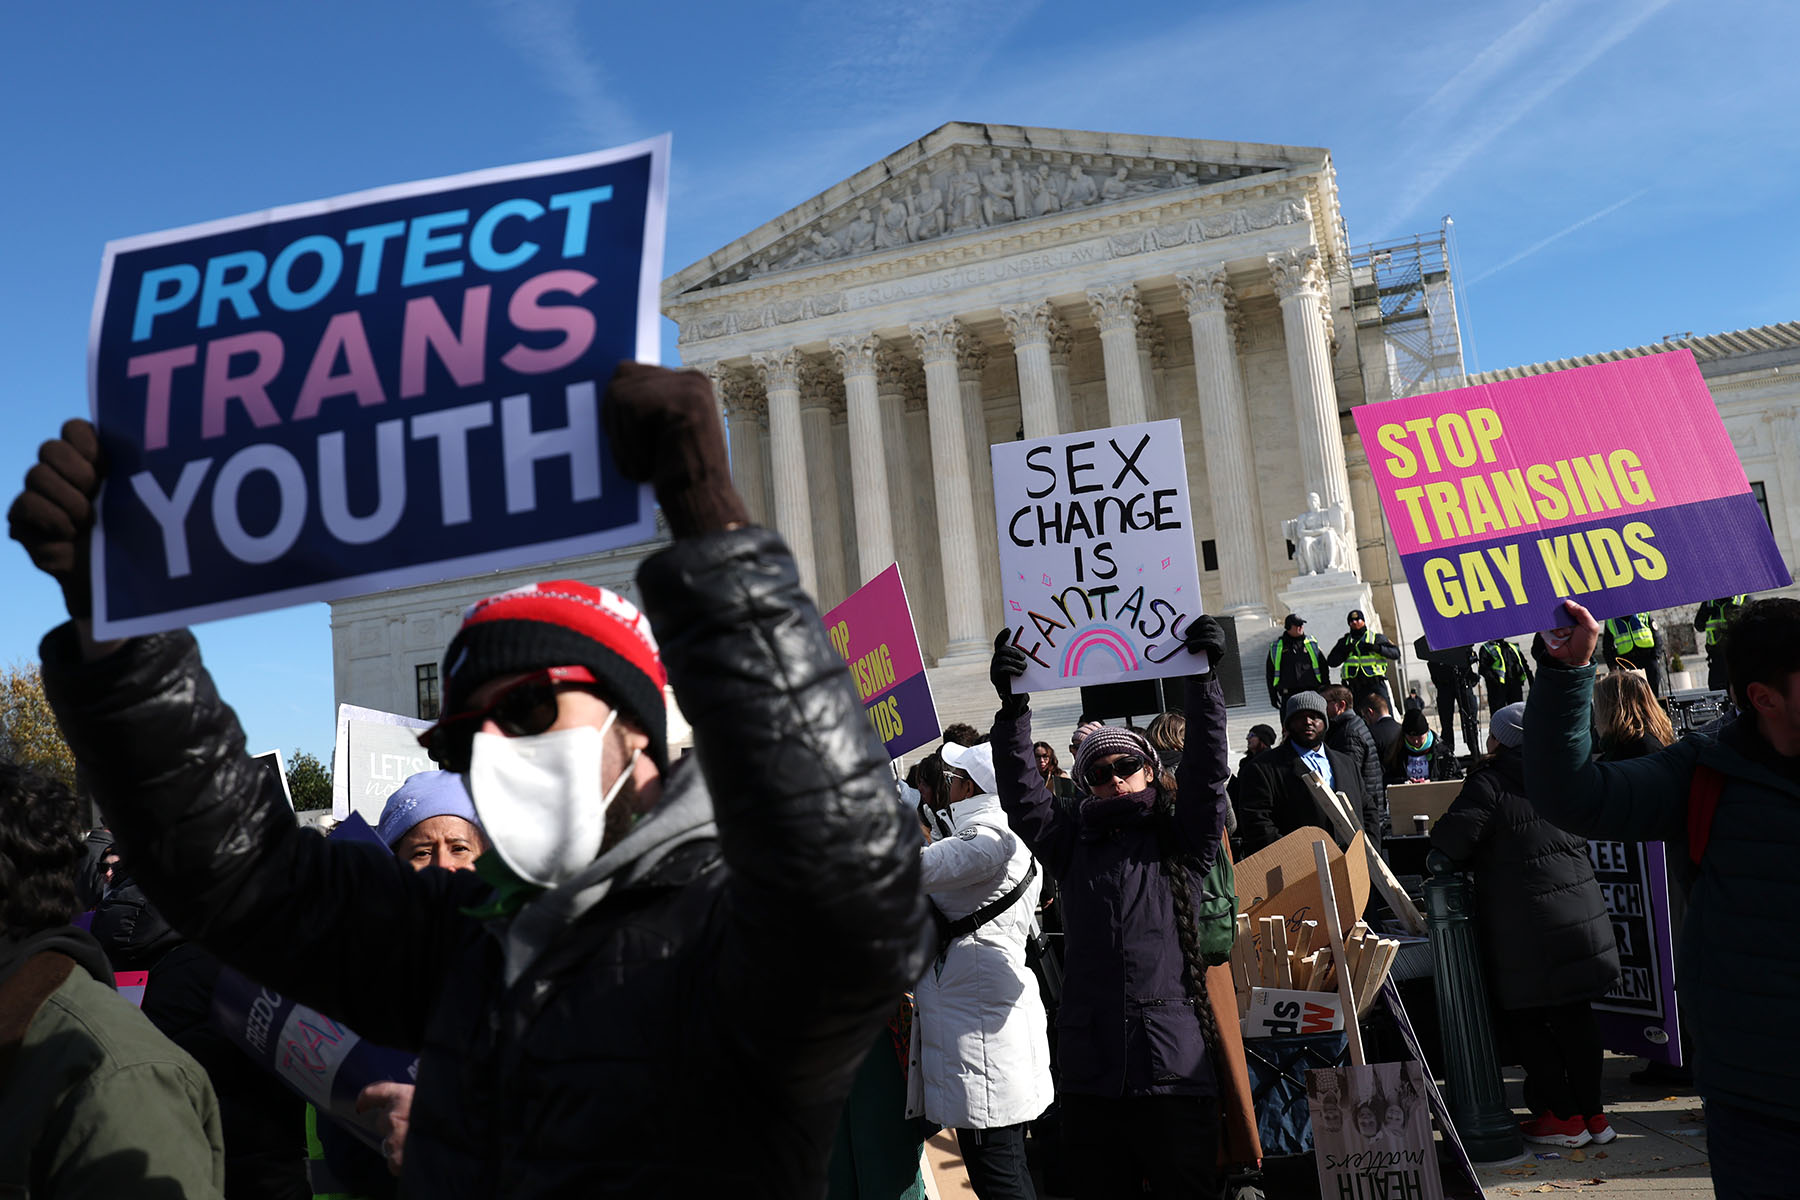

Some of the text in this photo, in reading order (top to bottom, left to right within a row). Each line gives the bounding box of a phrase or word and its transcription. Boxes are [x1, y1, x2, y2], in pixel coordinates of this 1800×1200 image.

[131, 185, 613, 341] PROTECT
[859, 247, 1096, 304] EQUAL JUSTICE UNDER LAW
[126, 269, 598, 451] TRANS
[1026, 433, 1151, 499] SEX
[1376, 407, 1503, 479] STOP
[129, 381, 602, 579] YOUTH
[1395, 448, 1656, 544] TRANSING
[1074, 541, 1118, 582] IS
[1423, 521, 1668, 619] GAY KIDS
[830, 620, 850, 661] OP
[848, 643, 897, 700] NSING
[1588, 842, 1626, 870] REE
[1326, 1149, 1425, 1176] matters
